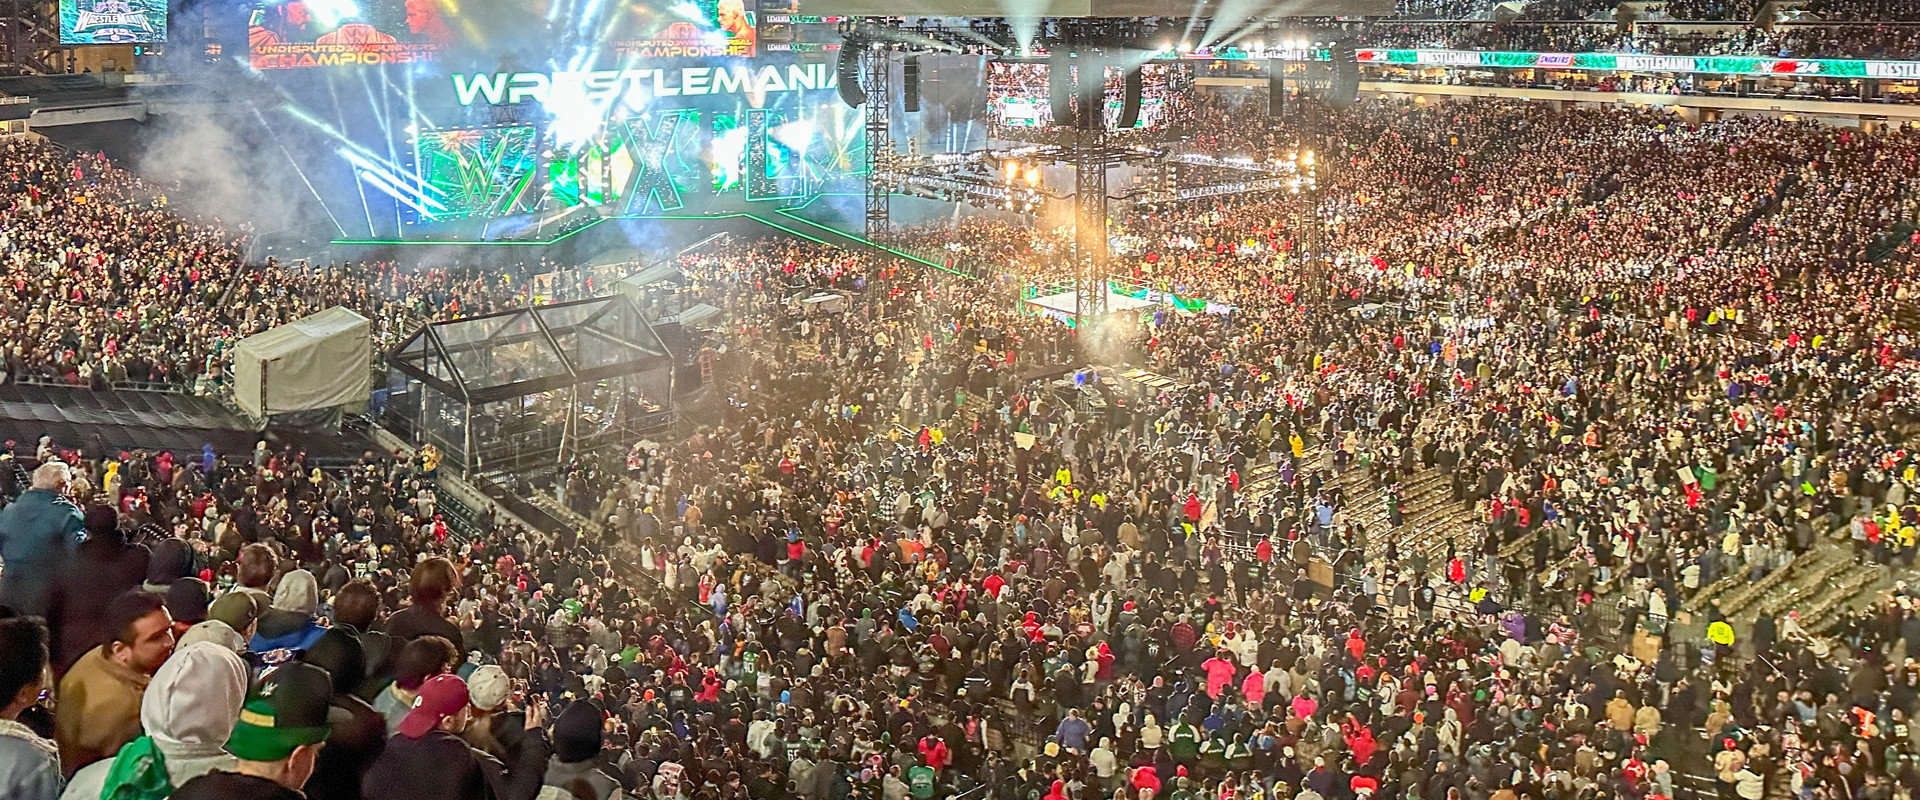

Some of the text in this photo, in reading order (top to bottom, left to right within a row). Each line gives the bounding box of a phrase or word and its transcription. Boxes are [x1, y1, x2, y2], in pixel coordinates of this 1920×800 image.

[256, 45, 345, 54] UNDISPUTED
[259, 52, 433, 68] CHAMPIONSHI
[1694, 58, 1719, 71] XL
[451, 62, 838, 105] WRSTLEMANI
